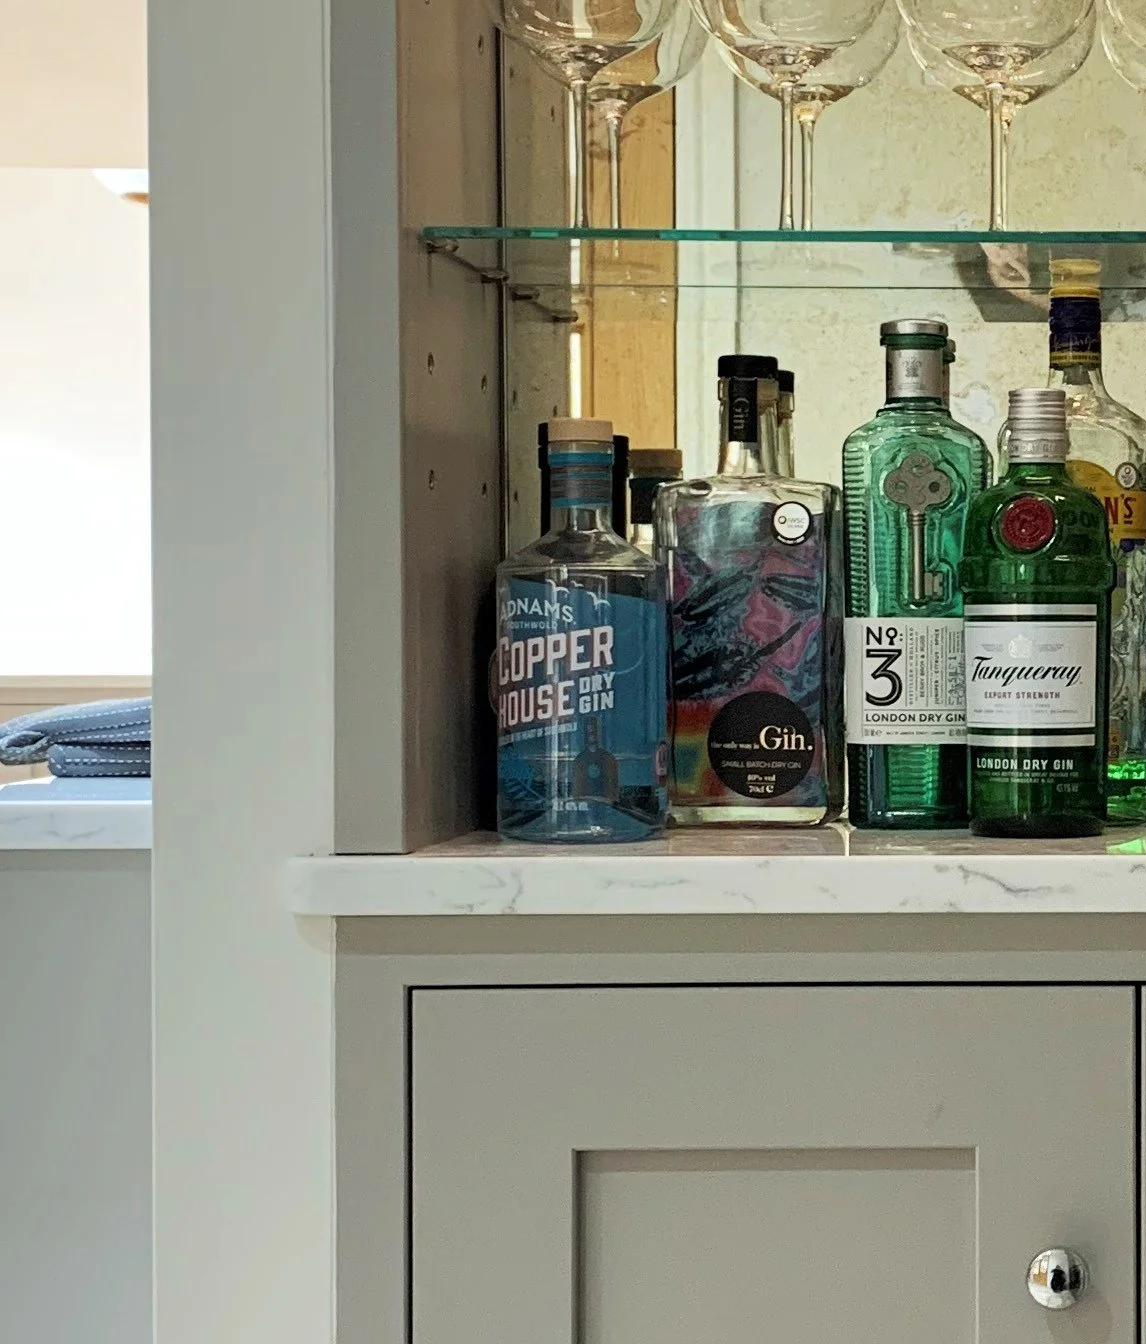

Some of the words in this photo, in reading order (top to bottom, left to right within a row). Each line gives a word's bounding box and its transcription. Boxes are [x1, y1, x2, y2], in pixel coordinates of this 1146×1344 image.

[732, 397, 750, 430] Gin
[500, 597, 575, 624] ADNAMS
[499, 625, 614, 686] COPPER
[578, 671, 616, 695] DRY
[865, 648, 903, 707] 3
[971, 656, 1082, 687] Tanqueray
[499, 680, 576, 729] HOUSE
[578, 690, 615, 714] GIN
[984, 691, 1012, 699] EXPORT
[1015, 691, 1061, 699] STRENGTH
[865, 713, 916, 723] LONDON
[919, 713, 942, 723] DRY
[945, 713, 966, 723] GIN
[721, 760, 746, 768] SMALL
[746, 760, 771, 769] BATCH
[771, 761, 787, 769] DRY
[787, 761, 802, 769] GIN
[976, 757, 1018, 770] LONDON
[1022, 759, 1049, 771] DRY
[1053, 759, 1074, 771] GIN
